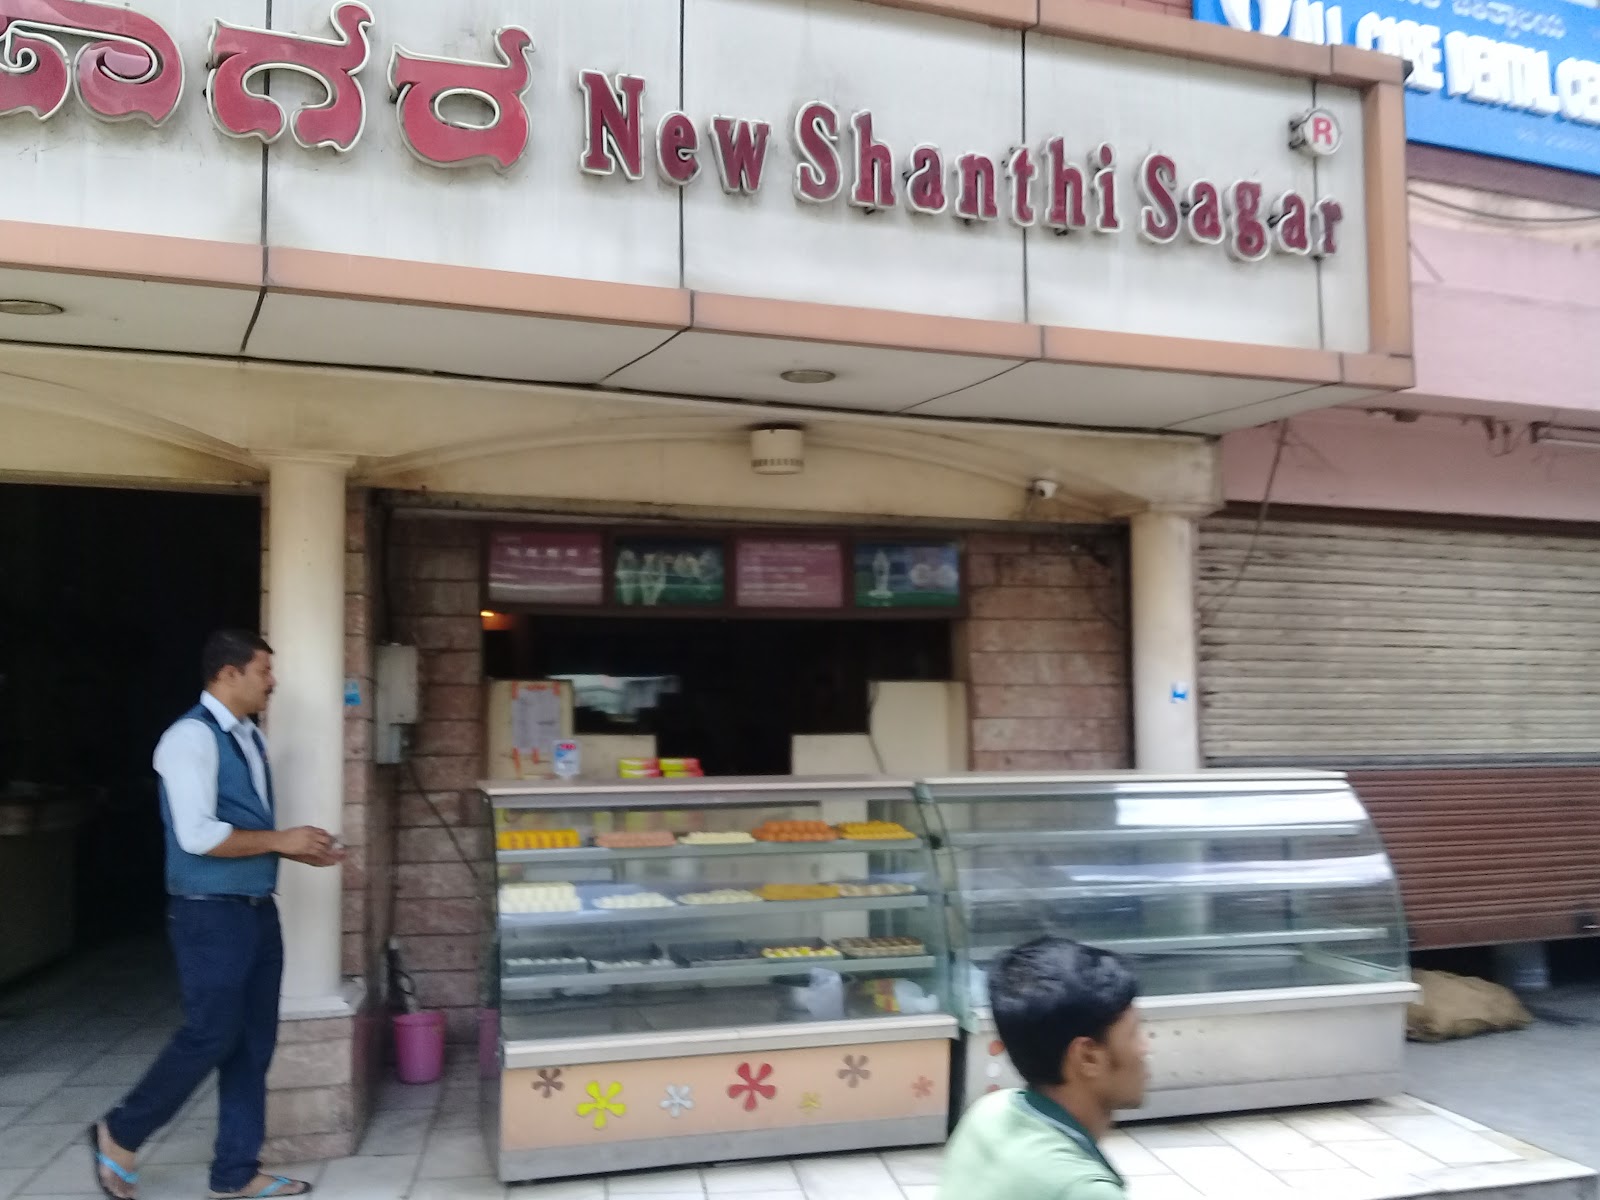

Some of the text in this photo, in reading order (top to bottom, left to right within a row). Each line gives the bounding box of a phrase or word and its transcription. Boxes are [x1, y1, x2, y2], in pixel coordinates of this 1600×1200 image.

[1444, 30, 1561, 113] DENTAL
[579, 69, 1343, 262] New Shanthi Sagar
